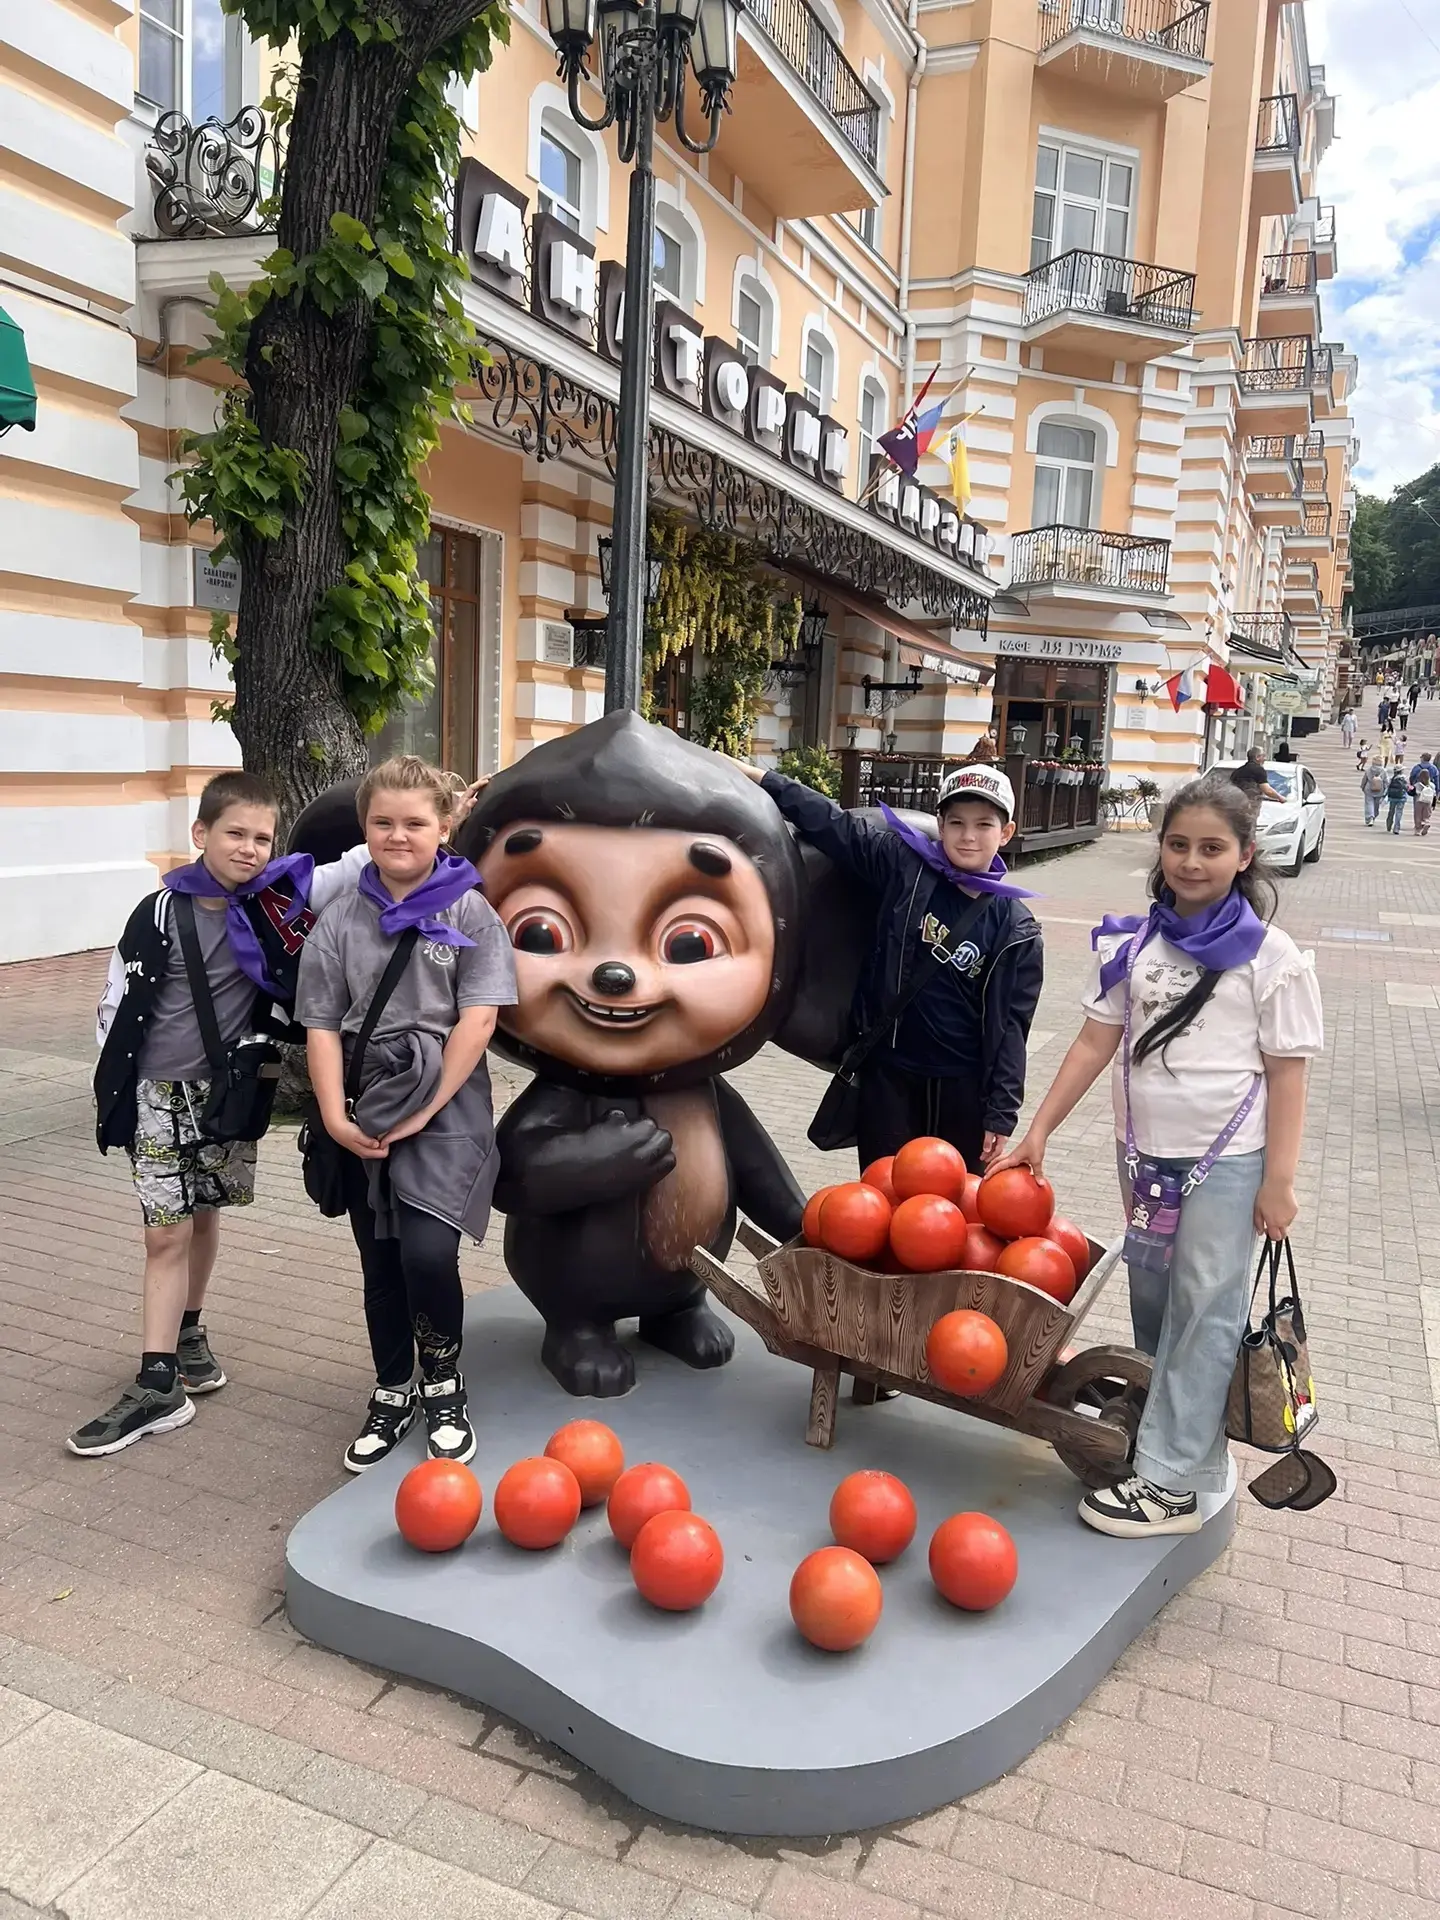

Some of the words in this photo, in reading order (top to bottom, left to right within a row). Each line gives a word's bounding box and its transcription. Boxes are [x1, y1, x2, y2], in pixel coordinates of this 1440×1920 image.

[475, 192, 850, 480] АНТОРИЙ
[999, 639, 1031, 652] КАФЕ
[1040, 640, 1062, 655] ЛЯ
[1068, 641, 1122, 658] ГУРМЭ
[946, 772, 1000, 796] MARVEL
[1167, 976, 1189, 988] Time
[1228, 1104, 1249, 1132] LOVELY
[423, 1342, 459, 1359] FILA
